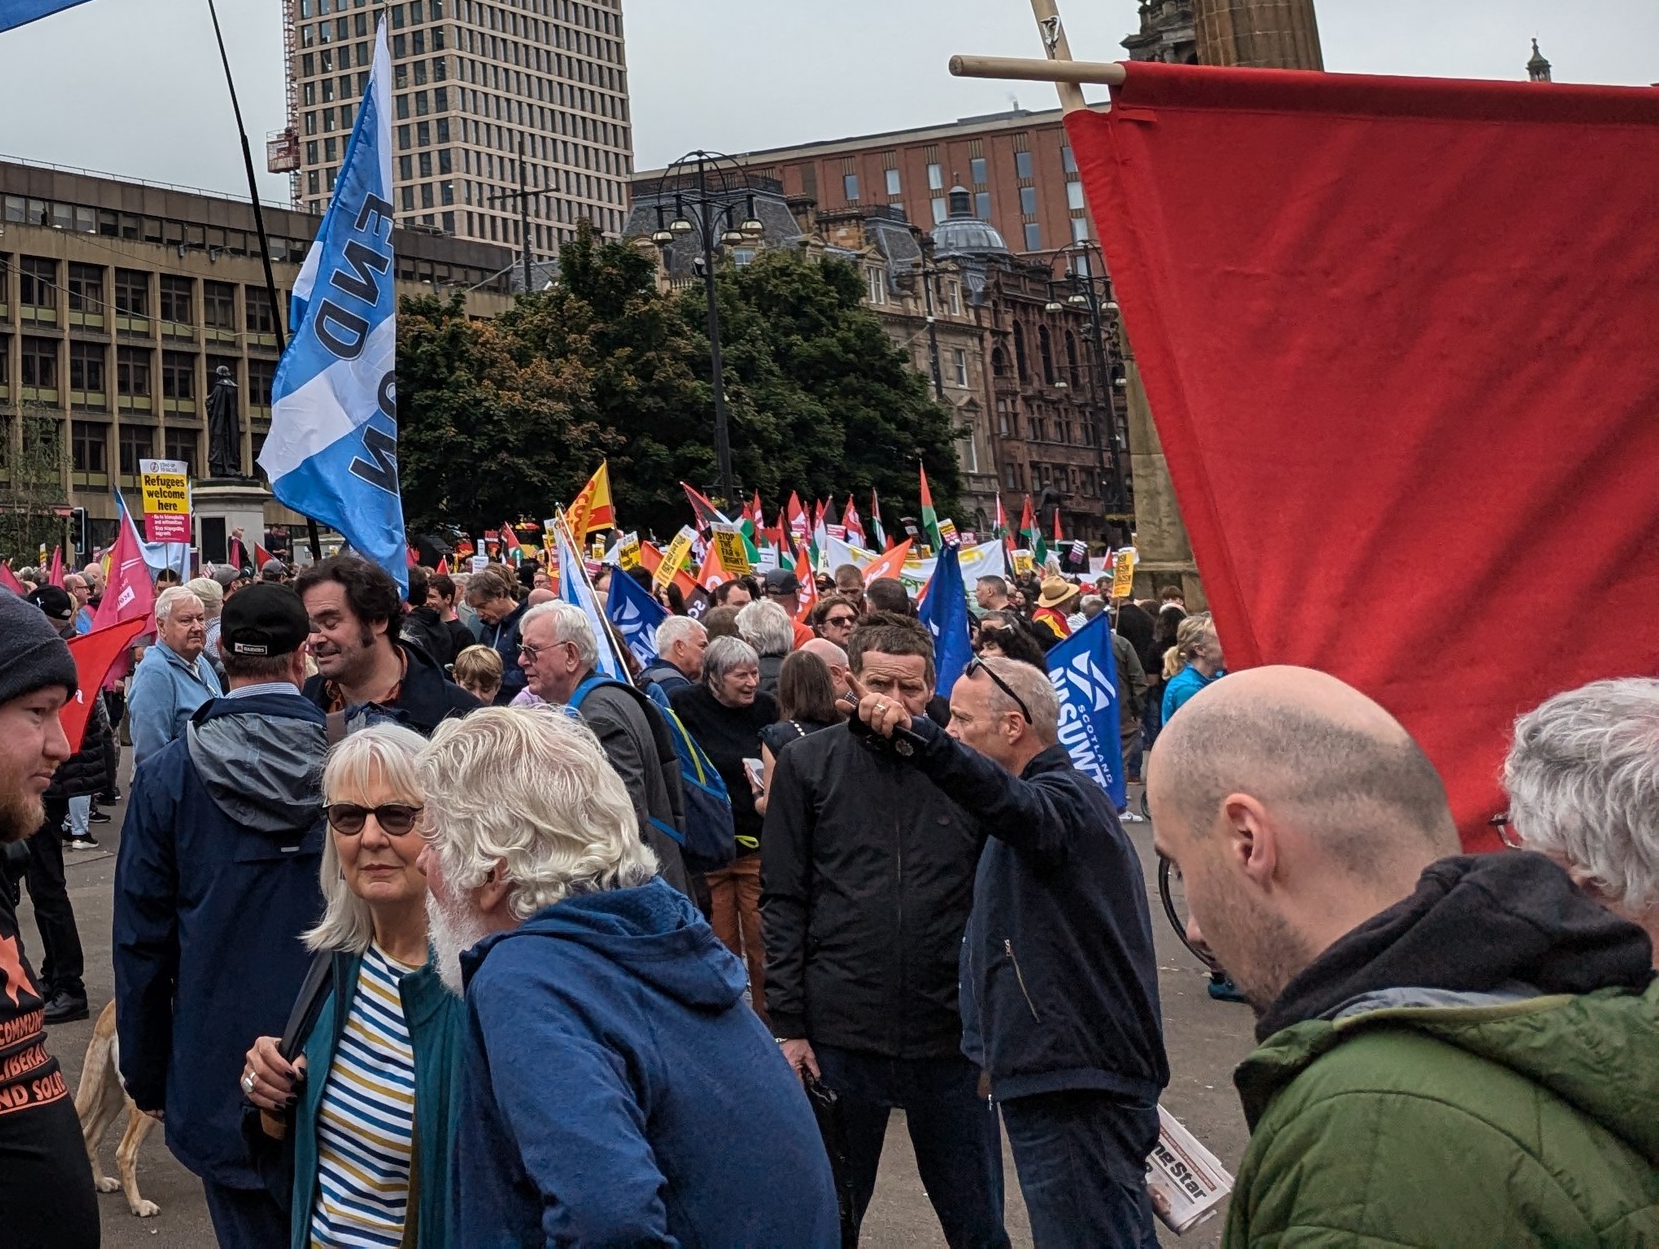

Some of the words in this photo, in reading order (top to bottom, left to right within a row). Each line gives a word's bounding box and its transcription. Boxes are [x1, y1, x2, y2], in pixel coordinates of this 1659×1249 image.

[144, 475, 185, 489] Refugees
[146, 488, 185, 500] welcome
[157, 500, 178, 511] here
[717, 532, 735, 541] STOP
[719, 540, 731, 548] THE
[722, 548, 733, 557] FAR
[1048, 666, 1108, 788] NASUWT
[1077, 704, 1113, 784] SCOTLAND
[1169, 1161, 1208, 1199] Star
